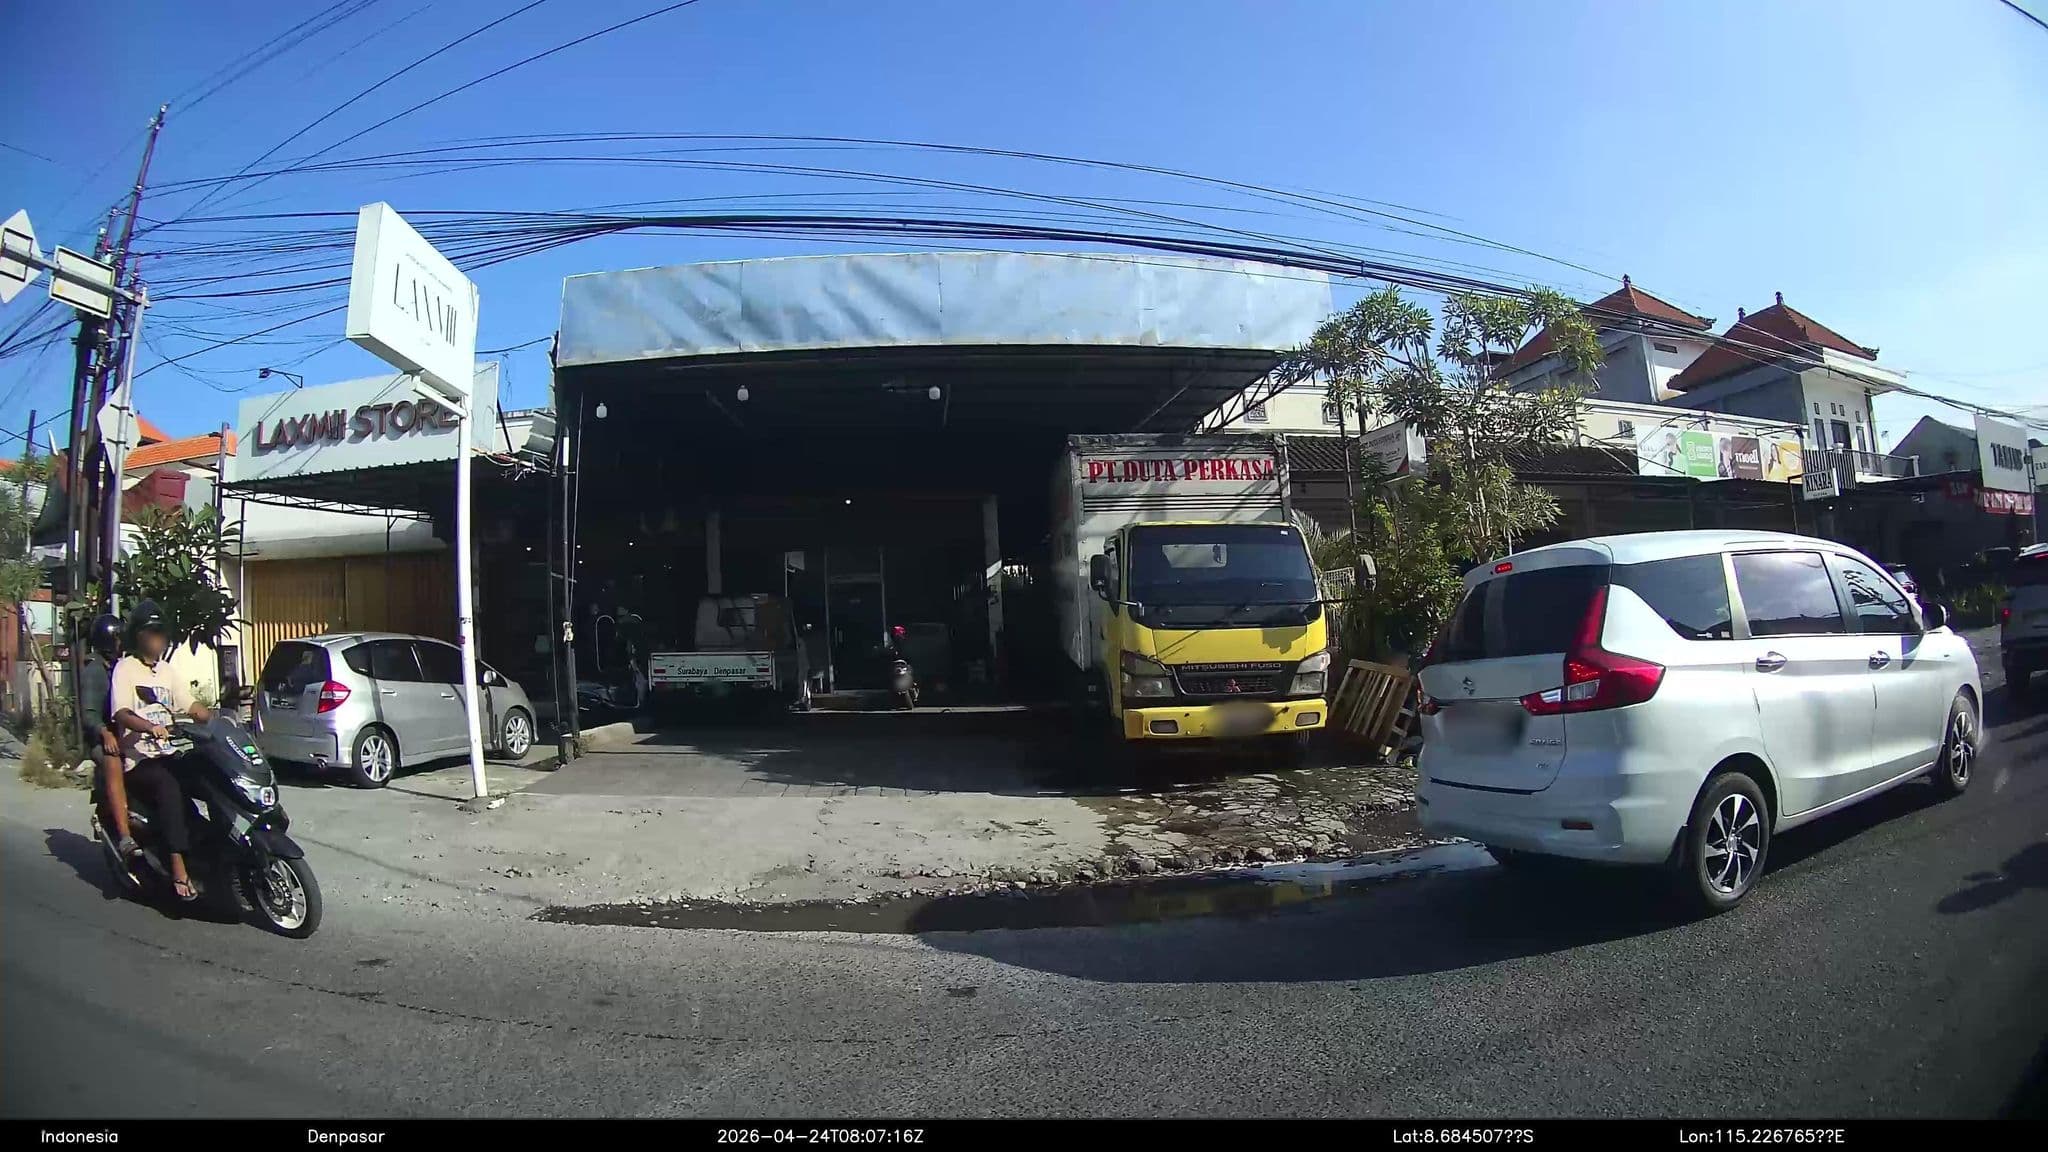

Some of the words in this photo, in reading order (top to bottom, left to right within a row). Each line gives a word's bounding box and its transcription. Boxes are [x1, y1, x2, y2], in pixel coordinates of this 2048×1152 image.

[257, 409, 348, 448] LAXMII
[355, 399, 459, 437] STORE
[1184, 458, 1276, 481] PERKASA
[1805, 472, 1833, 492] KINARA
[677, 667, 708, 675] Surabaya
[713, 667, 747, 676] Denpasar
[1181, 663, 1248, 671] MITSUBISHI
